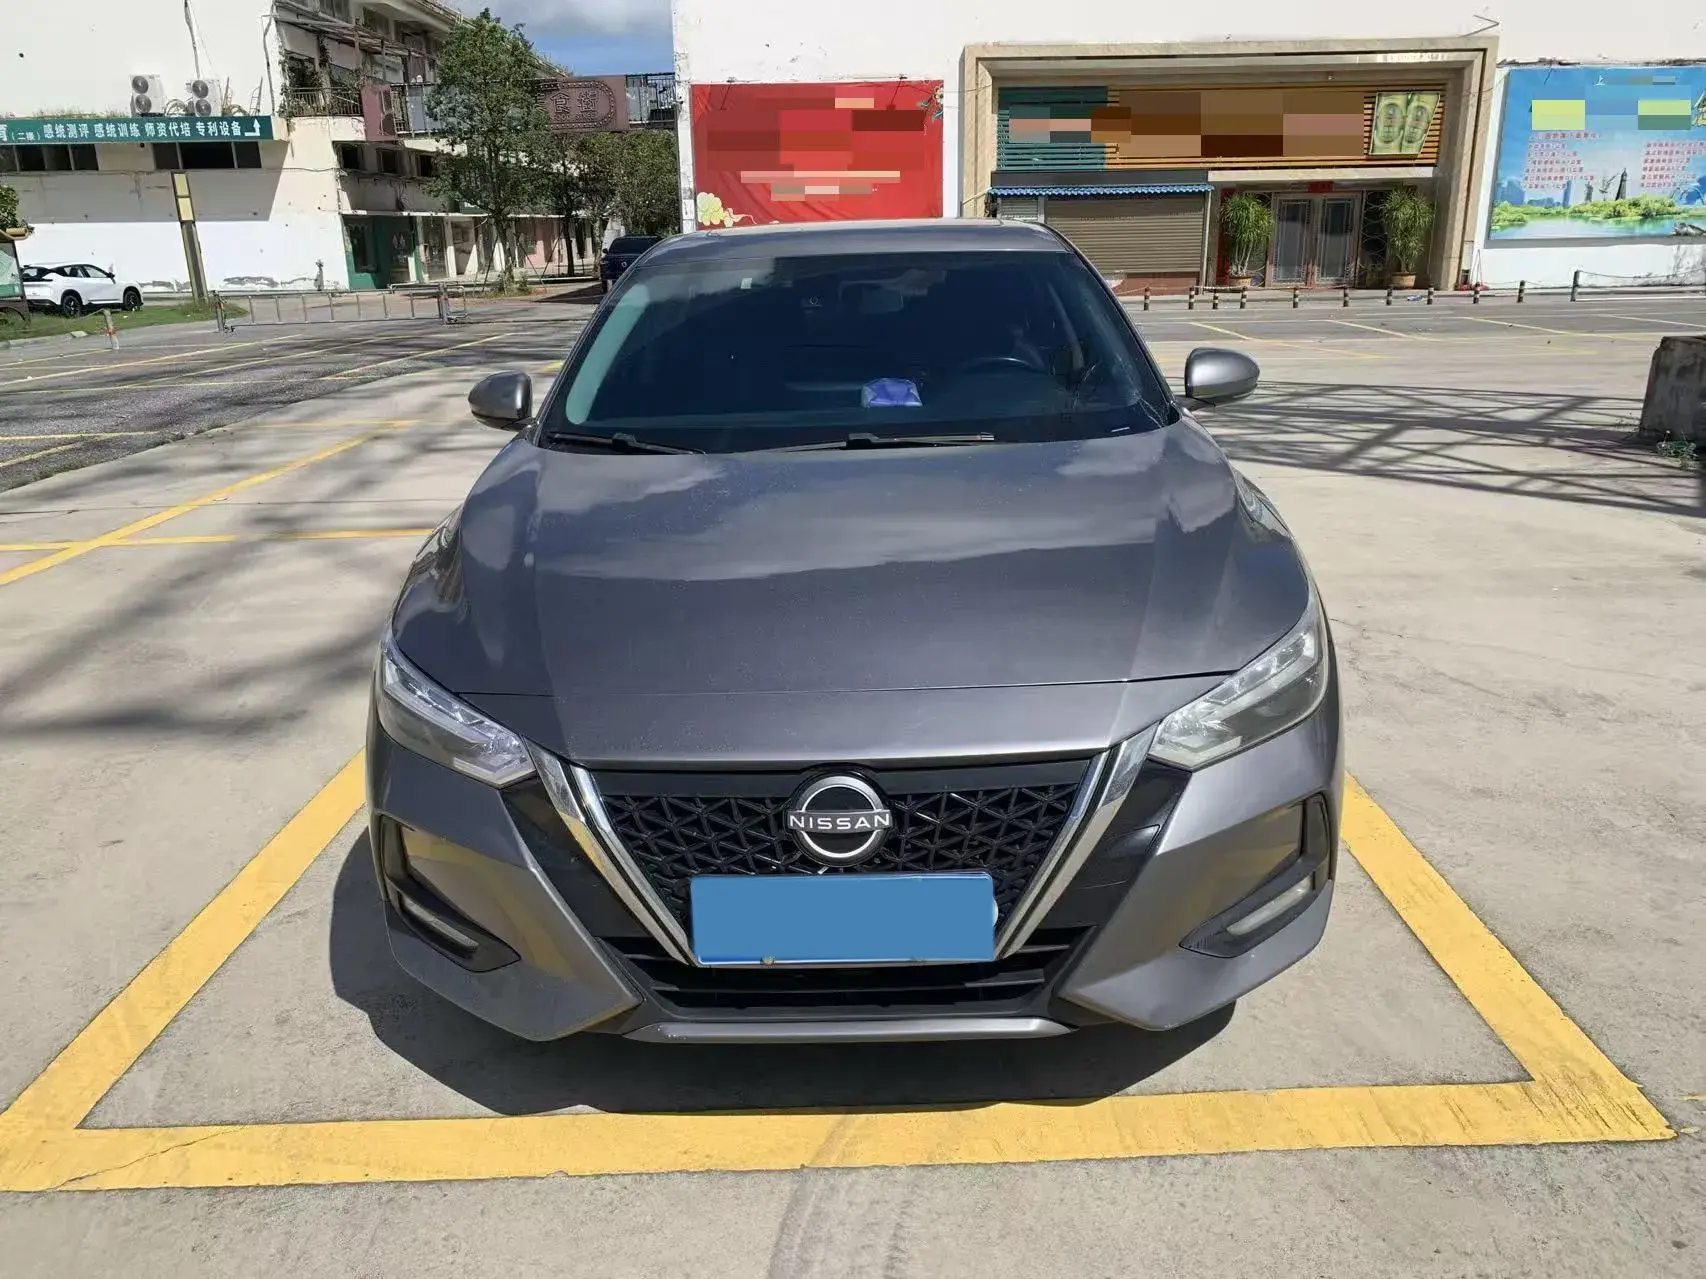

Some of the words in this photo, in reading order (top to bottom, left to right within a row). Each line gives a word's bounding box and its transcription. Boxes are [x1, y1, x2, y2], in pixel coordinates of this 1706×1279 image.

[43, 123, 89, 139] 感统测评
[94, 122, 141, 138] 感统训练
[144, 121, 191, 137] 师资代培
[195, 120, 242, 137] 专利设备
[789, 813, 890, 830] NISSAN
